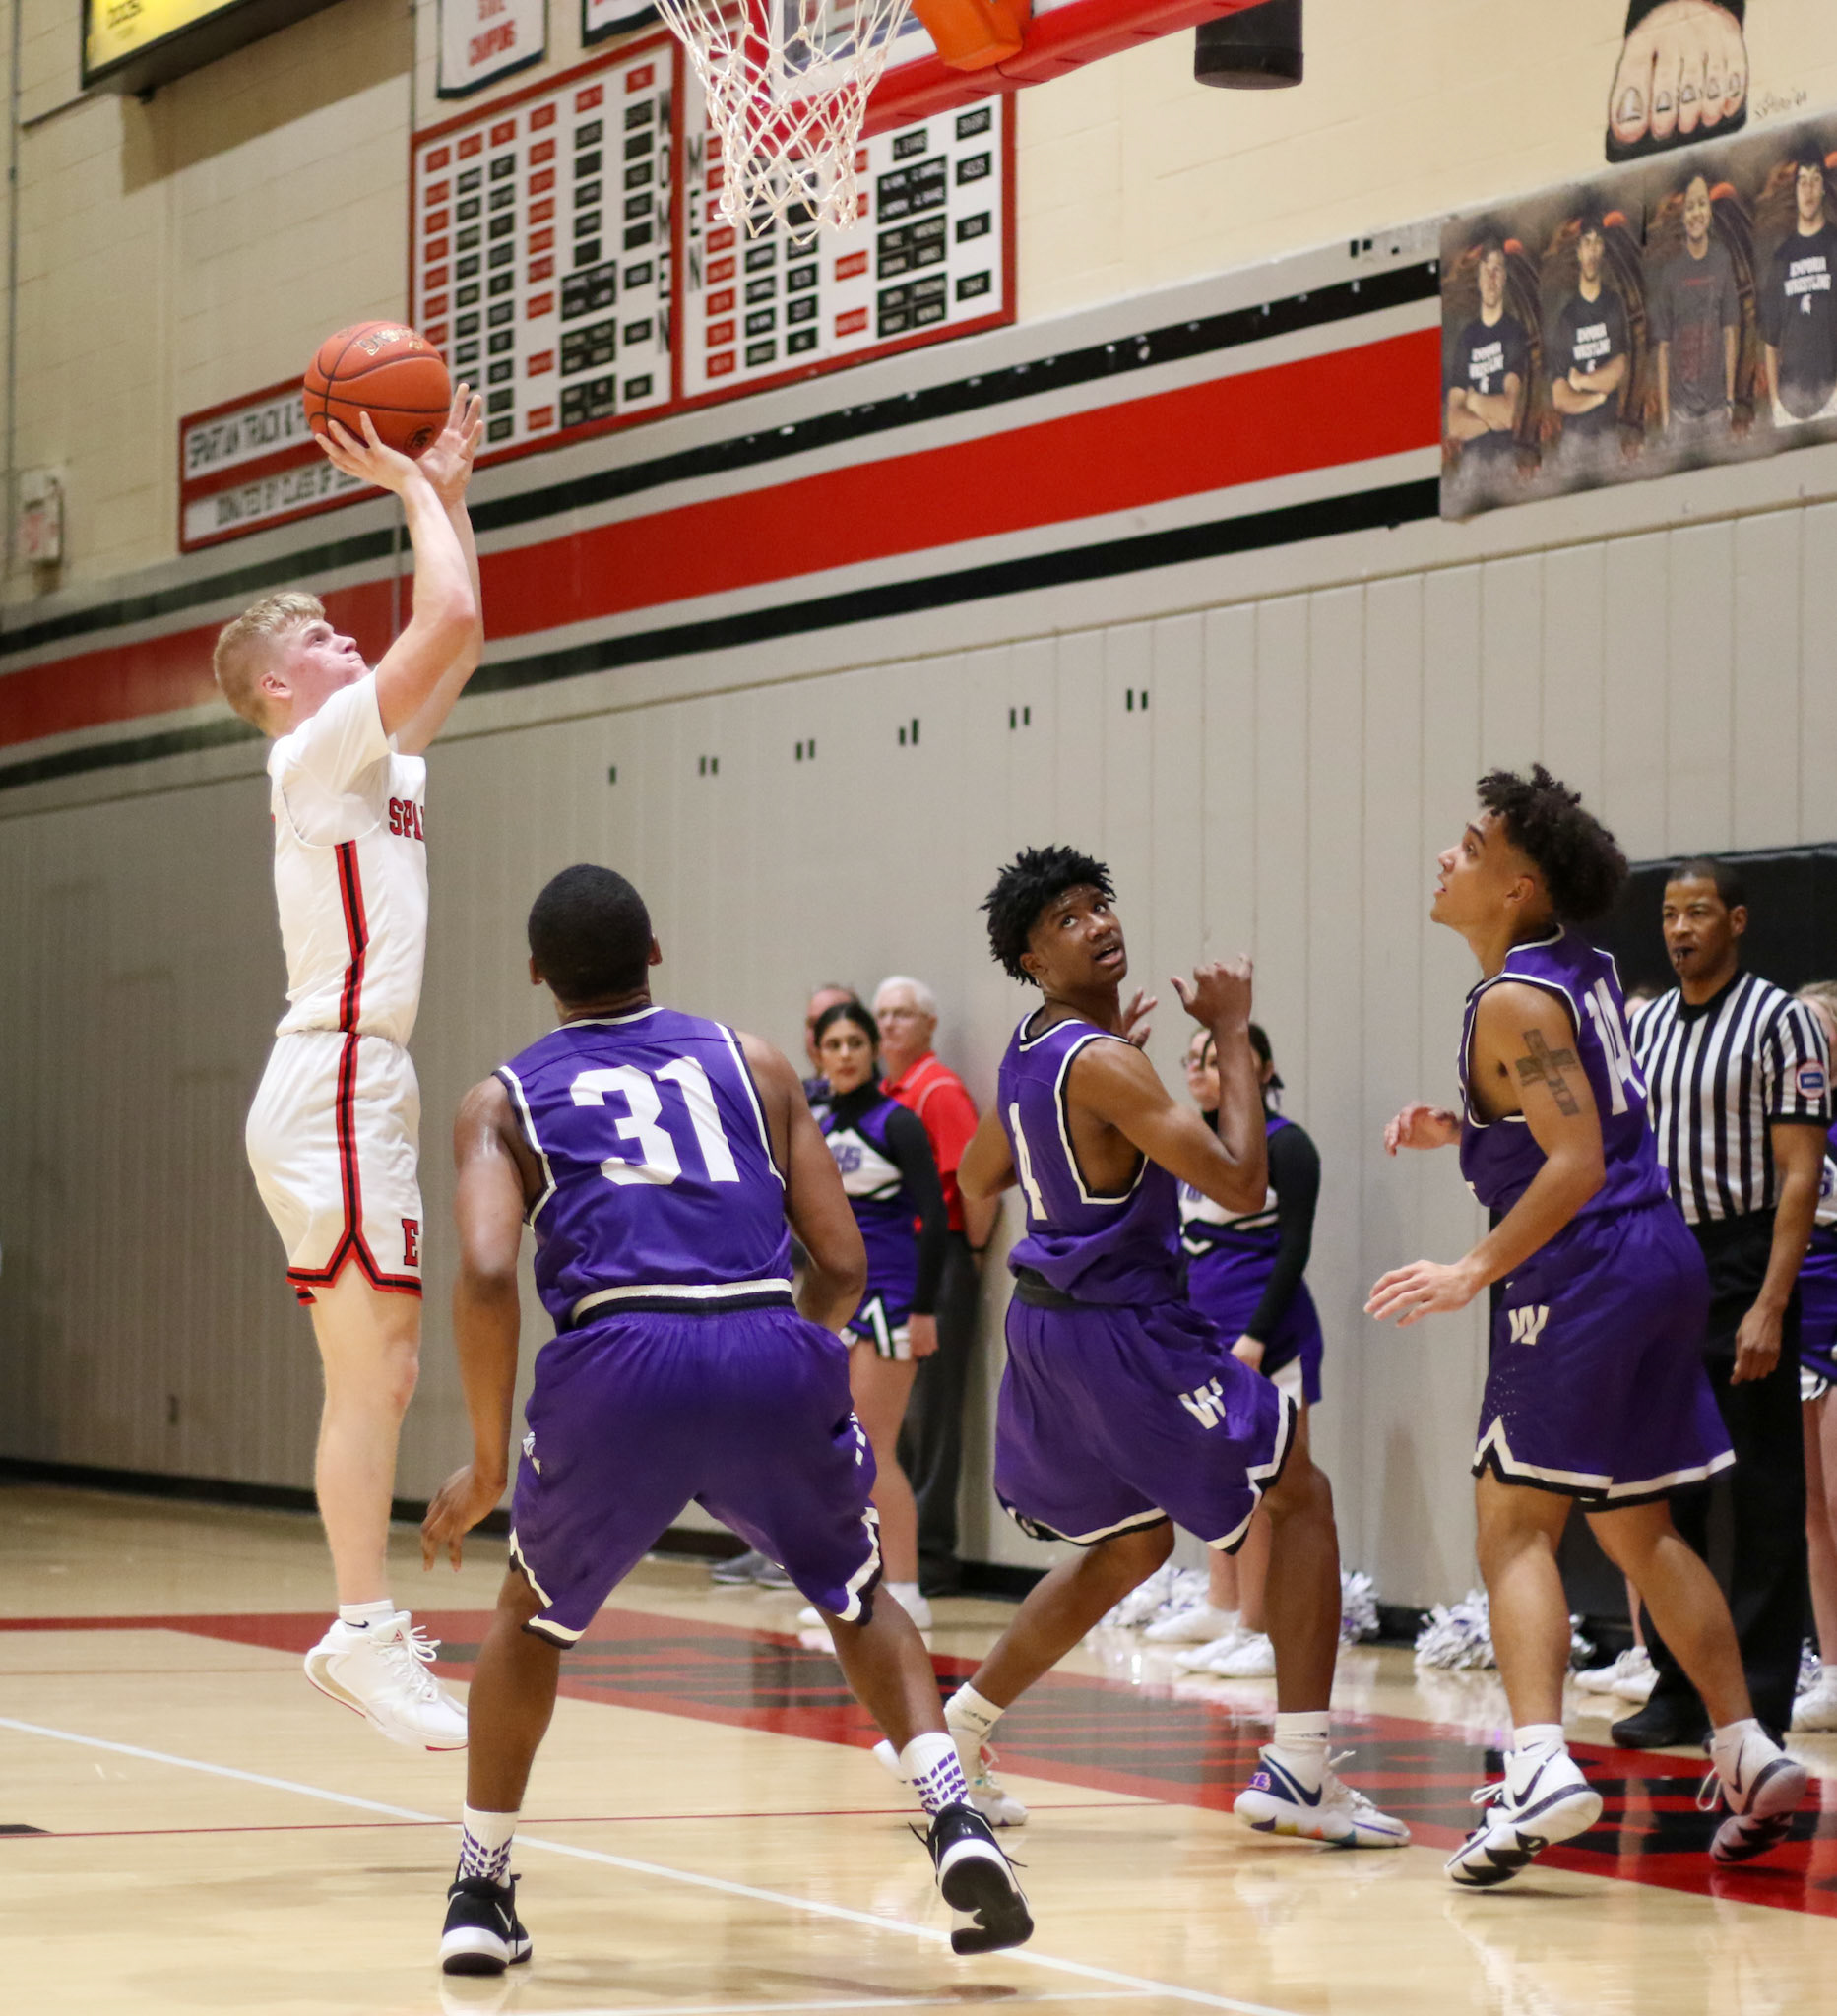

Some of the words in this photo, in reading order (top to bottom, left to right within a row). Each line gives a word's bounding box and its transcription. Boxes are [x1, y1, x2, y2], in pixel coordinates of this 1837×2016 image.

[389, 796, 425, 842] SPA
[1583, 976, 1647, 1116] 14
[569, 1055, 740, 1186] 31
[401, 1217, 420, 1268] E
[1507, 1304, 1550, 1347] W
